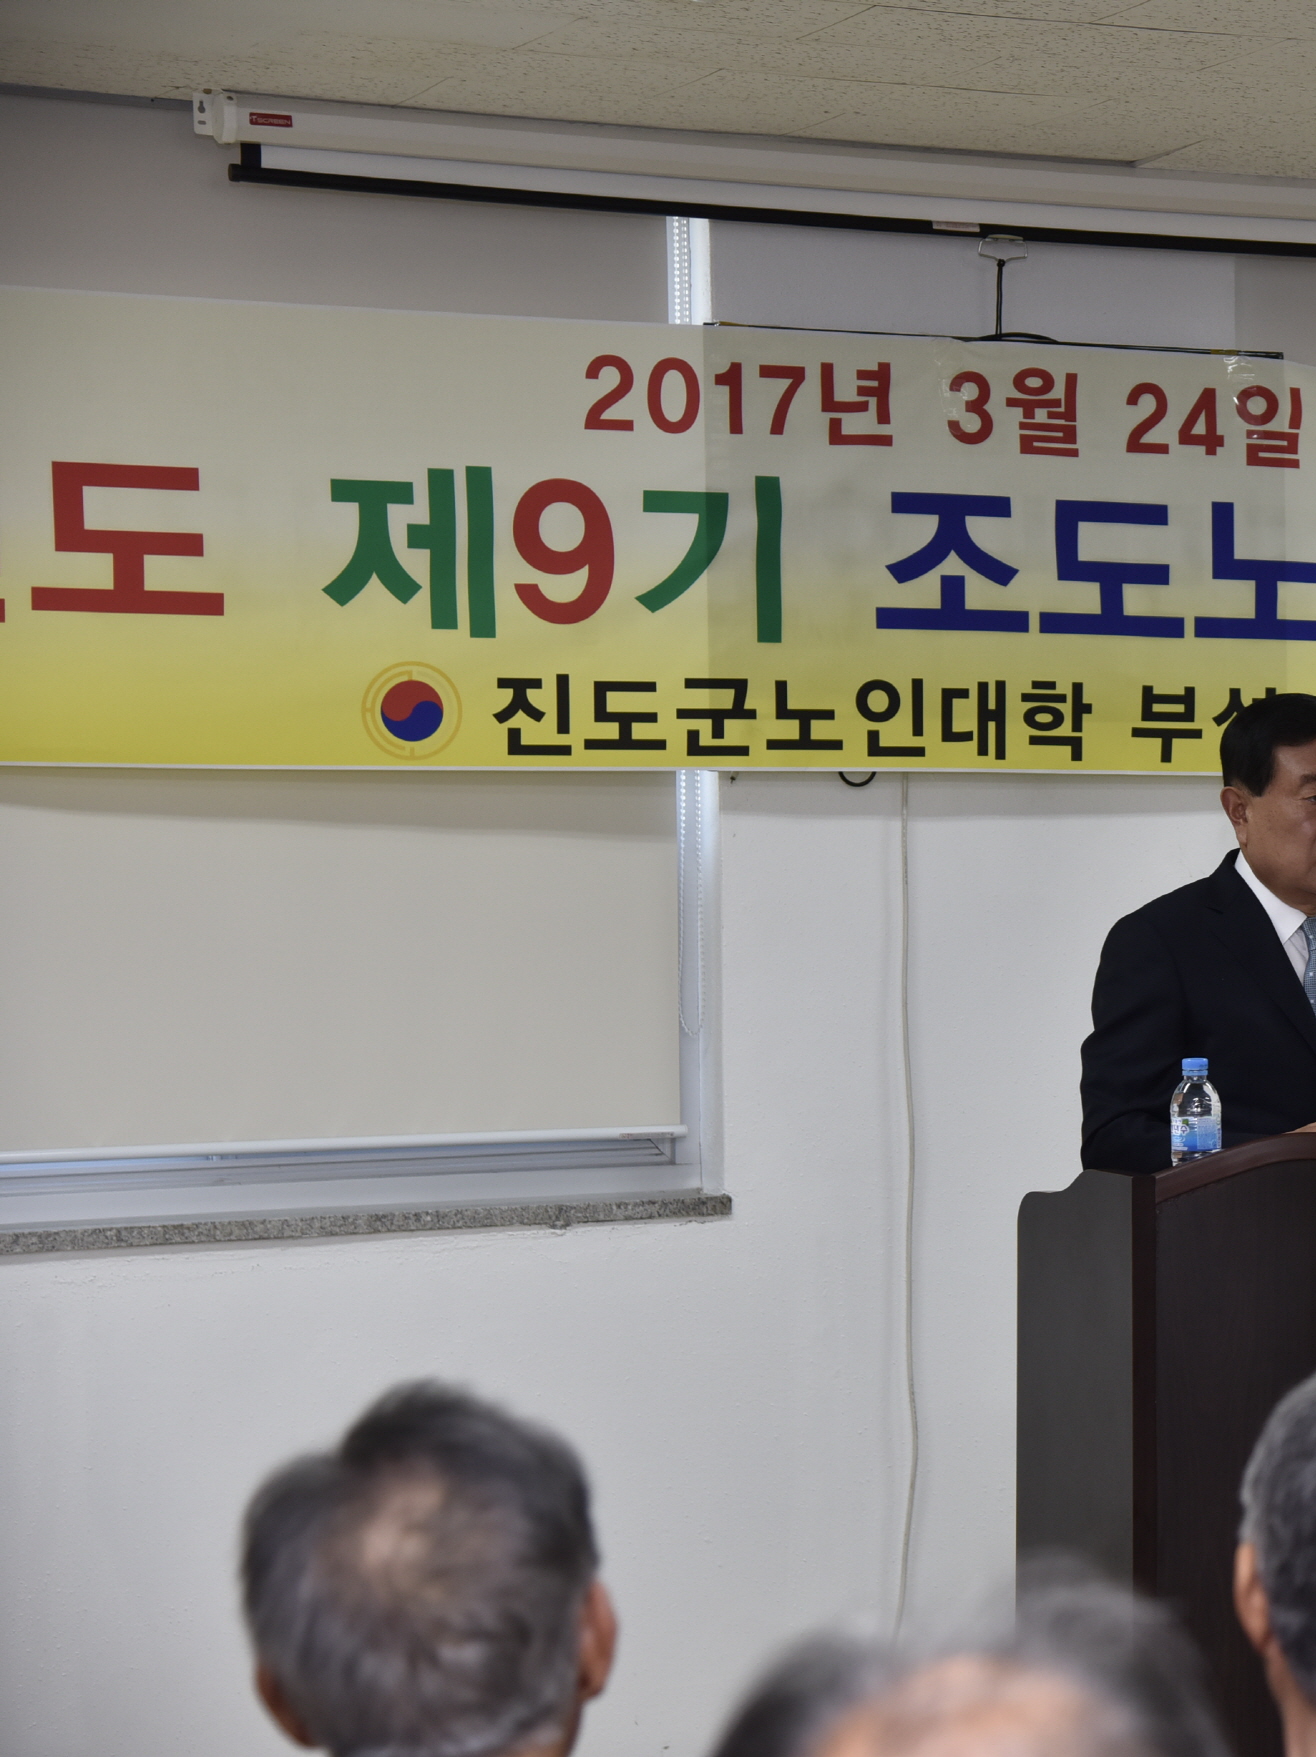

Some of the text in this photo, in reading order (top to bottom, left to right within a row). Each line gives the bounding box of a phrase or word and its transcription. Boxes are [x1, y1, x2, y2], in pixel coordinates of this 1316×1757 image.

[584, 354, 893, 447] 2017년
[948, 367, 1080, 458] 3월
[1126, 382, 1303, 469] 24일
[0, 461, 225, 623] 도
[322, 466, 782, 644] 제9기
[492, 673, 1093, 762] 진도군노인대학
